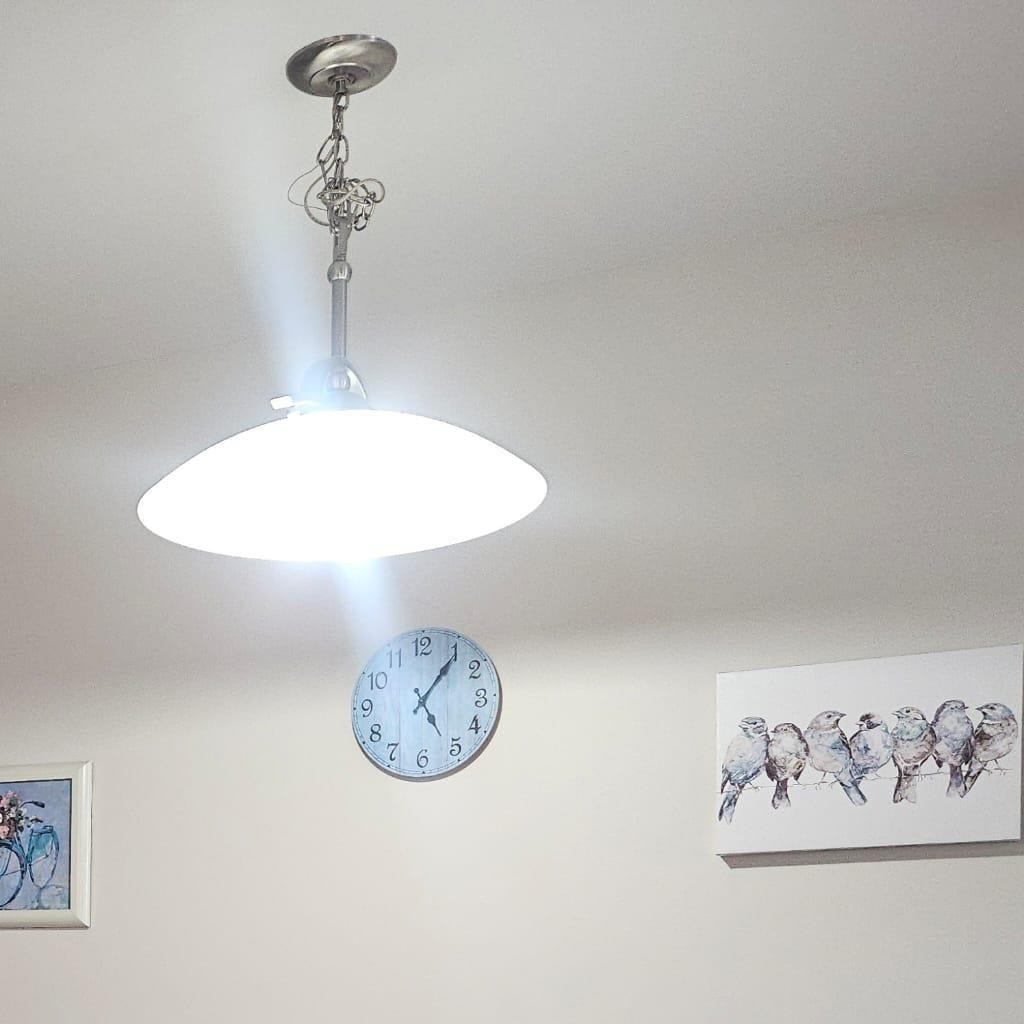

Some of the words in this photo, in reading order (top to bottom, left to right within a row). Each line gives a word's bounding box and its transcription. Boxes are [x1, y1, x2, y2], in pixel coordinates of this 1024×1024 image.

[412, 636, 432, 657] 12
[451, 643, 458, 661] 1
[386, 647, 402, 668] 11
[468, 660, 481, 679] 2
[367, 671, 388, 690] 10
[474, 688, 488, 708] 3
[361, 699, 373, 717] 9
[369, 723, 382, 742] 8
[468, 715, 481, 734] 4
[386, 742, 399, 761] 7
[449, 736, 462, 756] 5
[416, 749, 429, 768] 6
